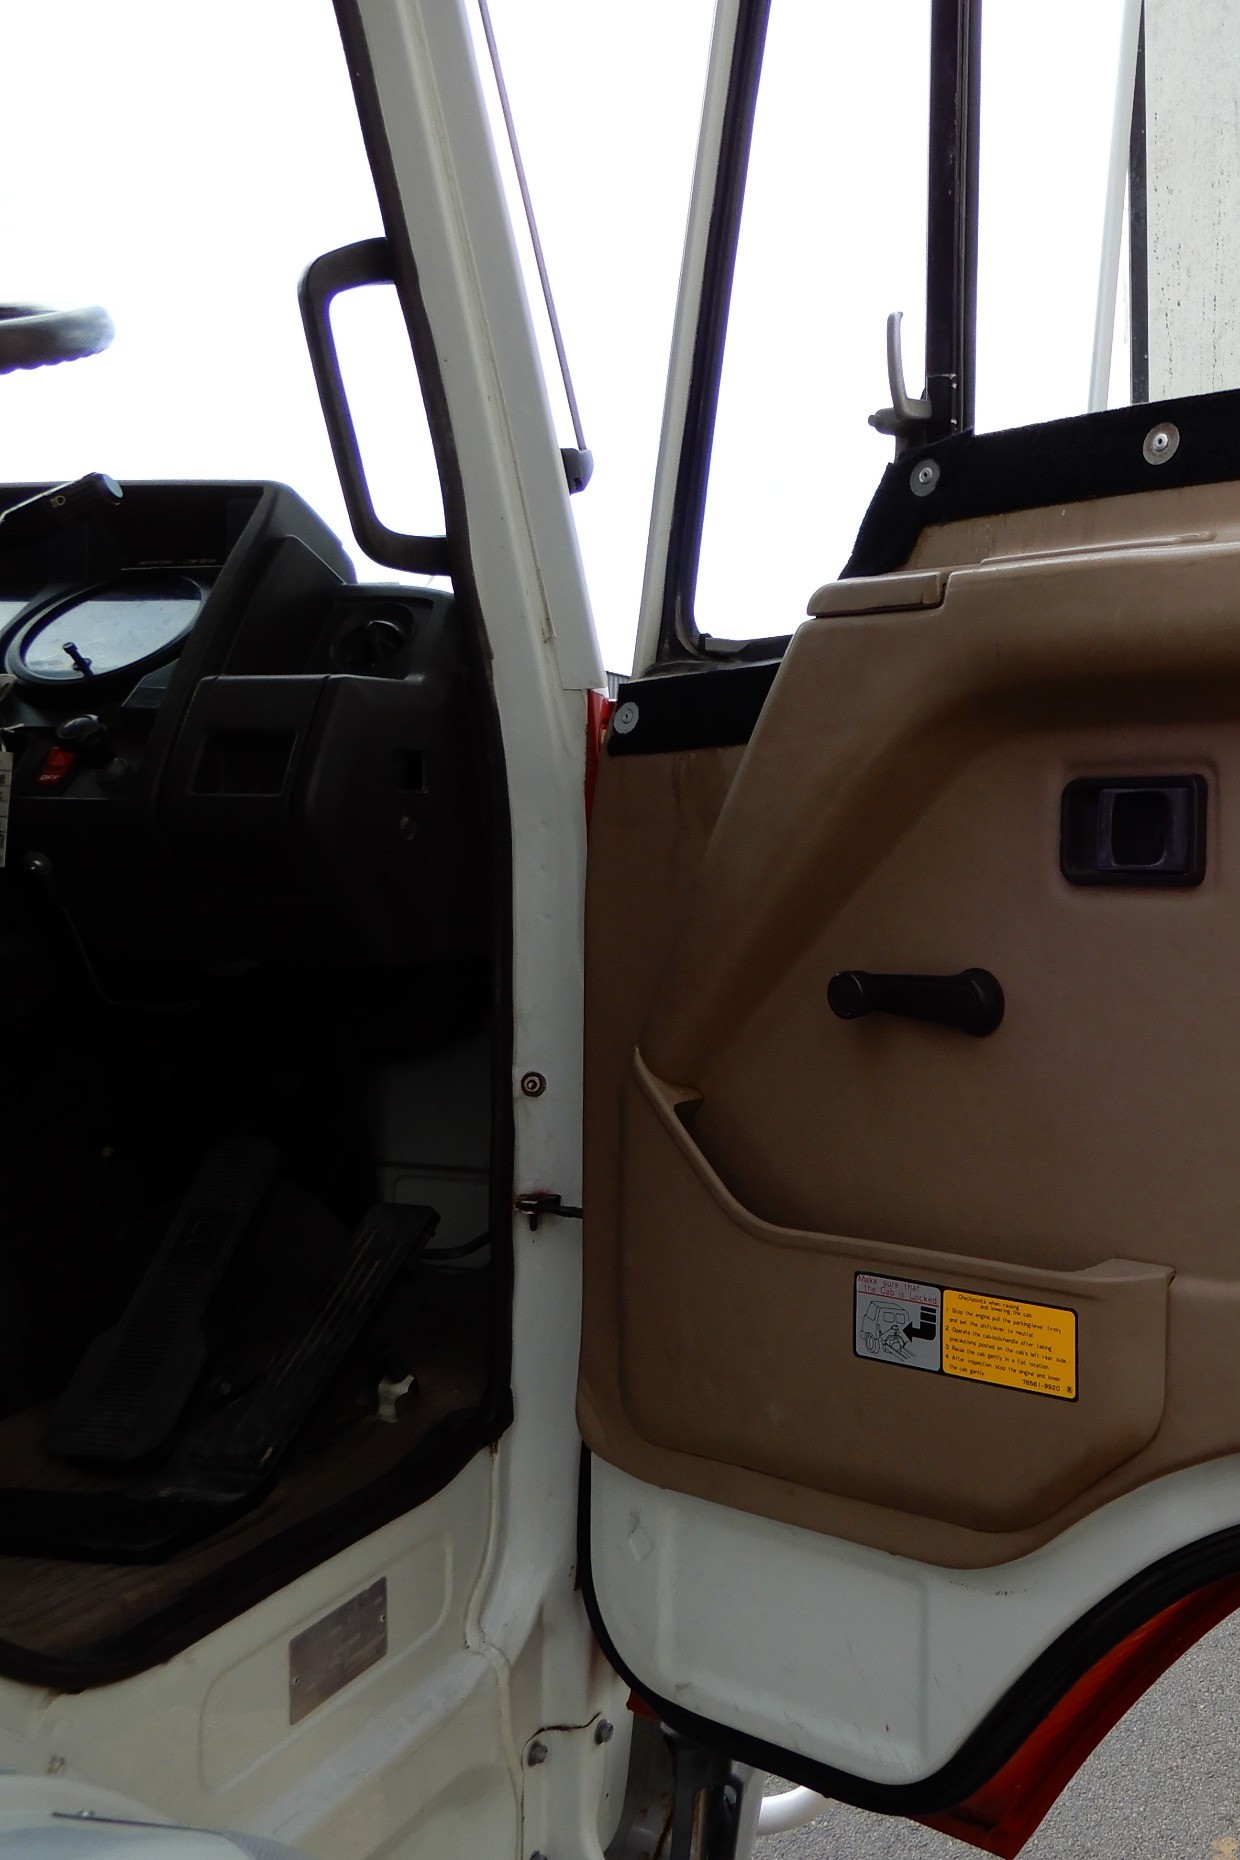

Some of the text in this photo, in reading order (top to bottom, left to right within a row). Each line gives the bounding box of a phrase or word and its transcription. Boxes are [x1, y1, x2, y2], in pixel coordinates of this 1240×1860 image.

[858, 1275, 920, 1291] Make sure that
[864, 1284, 875, 1292] the
[880, 1287, 895, 1296] Cab
[909, 1292, 937, 1304] Locked
[958, 1294, 986, 1304] Checkpoints
[1002, 1303, 1020, 1311] raising
[952, 1307, 963, 1315] Stop
[990, 1305, 1011, 1315] lowering
[949, 1337, 976, 1346] precautions
[952, 1327, 971, 1335] Operate
[1037, 1344, 1052, 1352] taking
[995, 1364, 1006, 1372] stop
